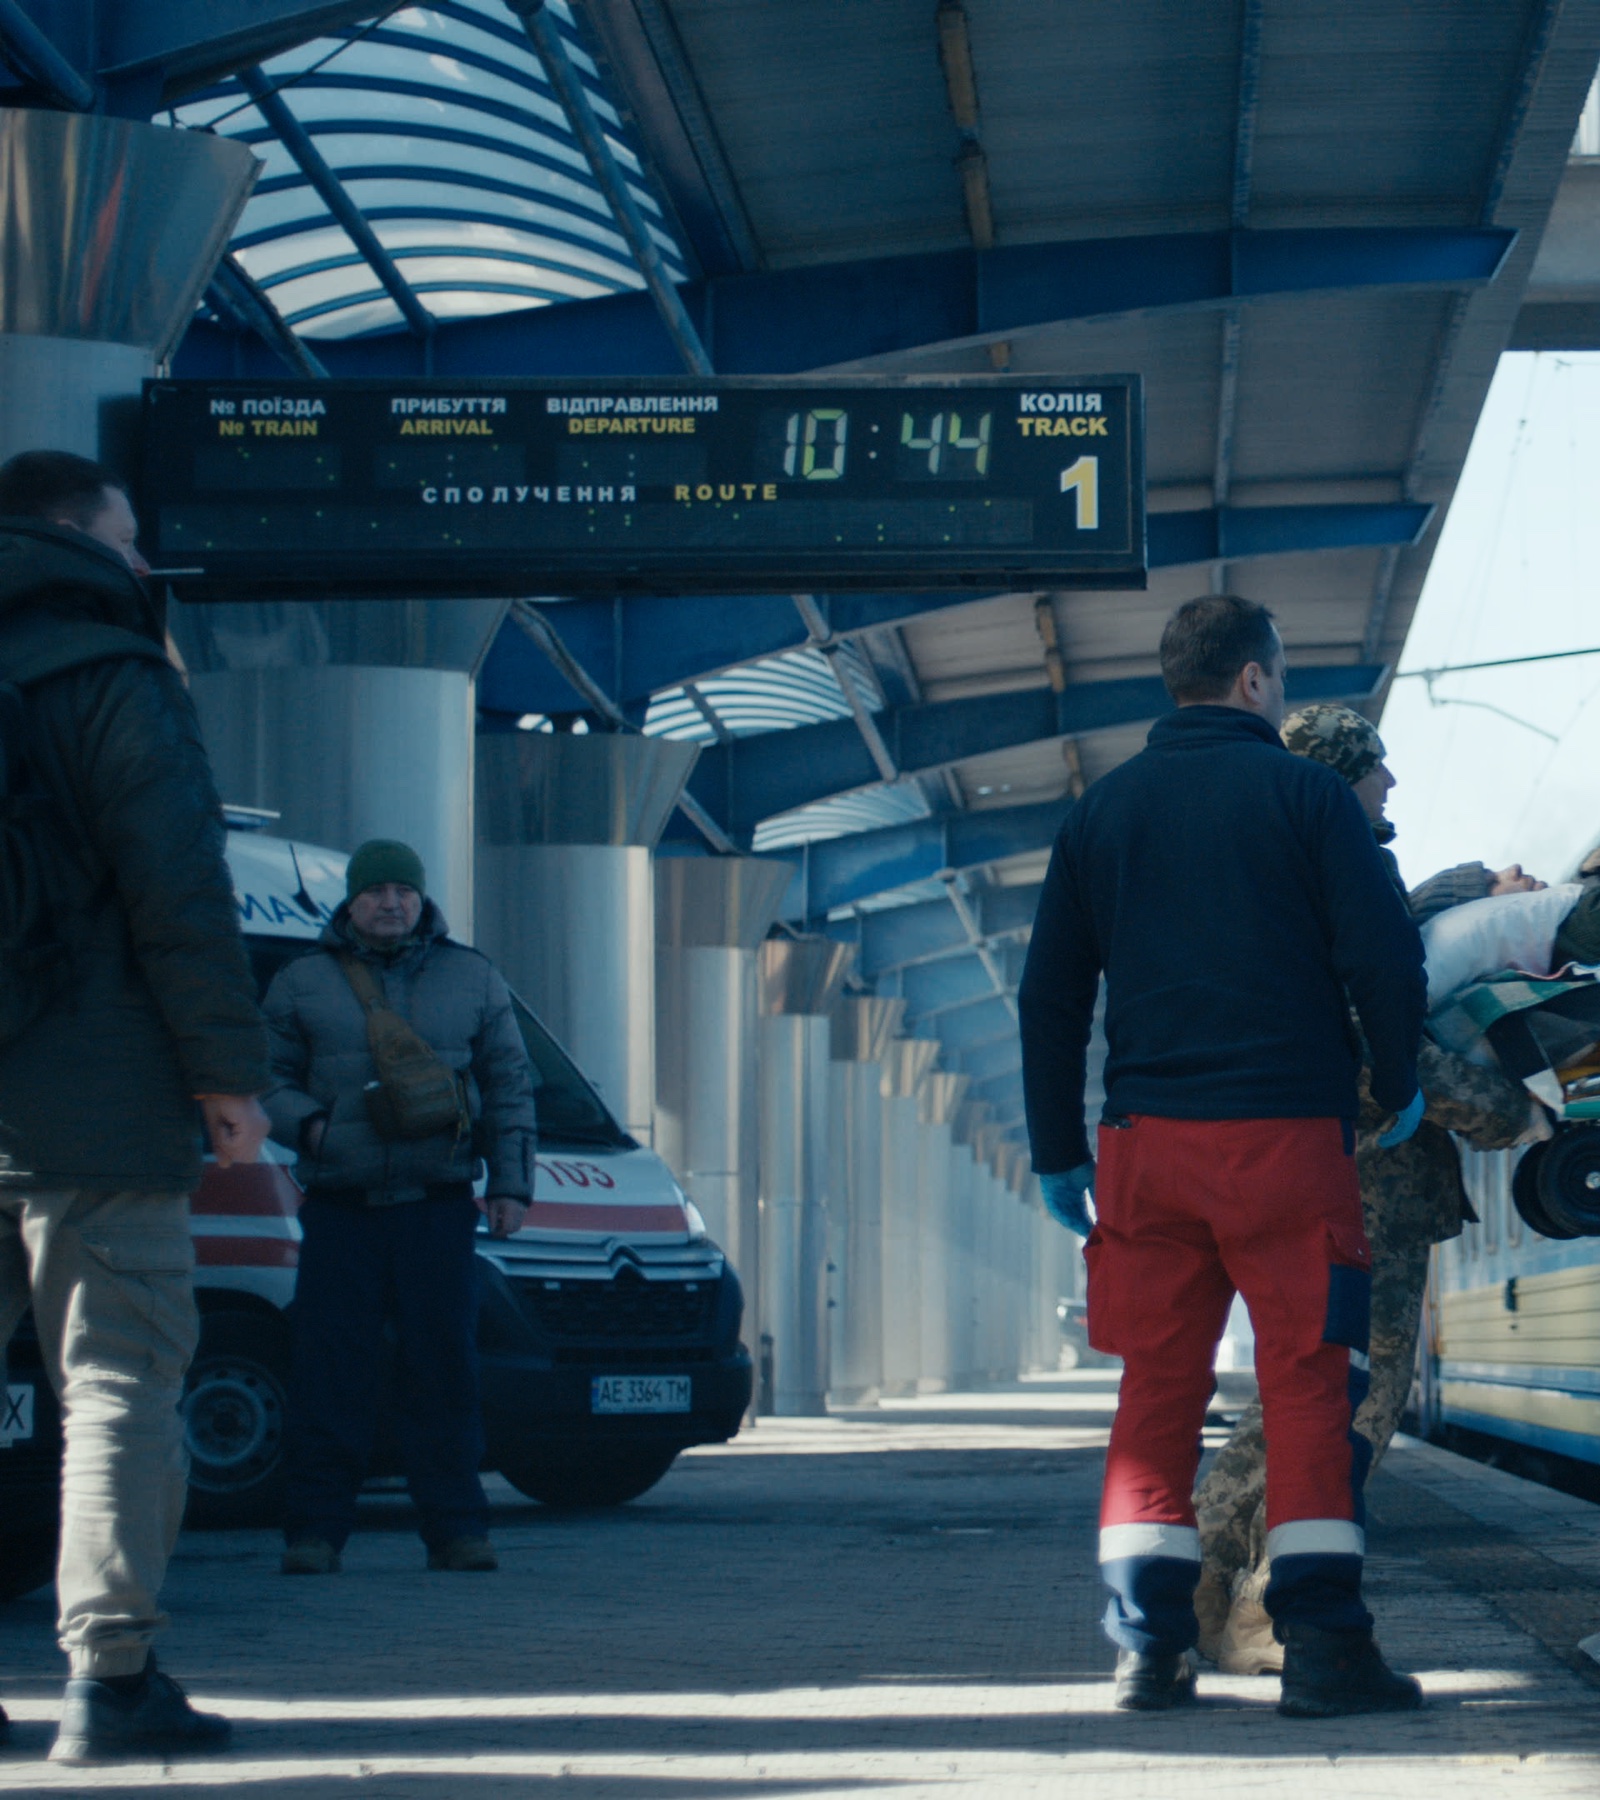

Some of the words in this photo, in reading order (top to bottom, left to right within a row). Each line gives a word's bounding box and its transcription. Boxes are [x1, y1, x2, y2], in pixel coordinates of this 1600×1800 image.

[210, 400, 235, 415] №
[243, 397, 326, 416] ПОЇЗДА
[391, 398, 506, 413] ПРИБУТТЯ
[547, 396, 718, 415] ВІДПРАВЛЕННЯ
[1020, 394, 1101, 412] КОЛІЯ
[219, 420, 245, 435] №
[251, 420, 318, 435] TRAIN
[400, 419, 493, 435] ARRIVAL
[568, 418, 695, 433] DEPARTURE
[1017, 417, 1107, 436] TRACK
[784, 409, 991, 480] 10:44
[423, 486, 635, 503] СПОЛУЧЕННЯ
[675, 484, 778, 500] ROUTE
[1060, 456, 1098, 530] 1
[533, 1159, 615, 1188] 103
[600, 1380, 623, 1402] AE
[628, 1380, 661, 1402] 3364
[666, 1380, 688, 1402] TM
